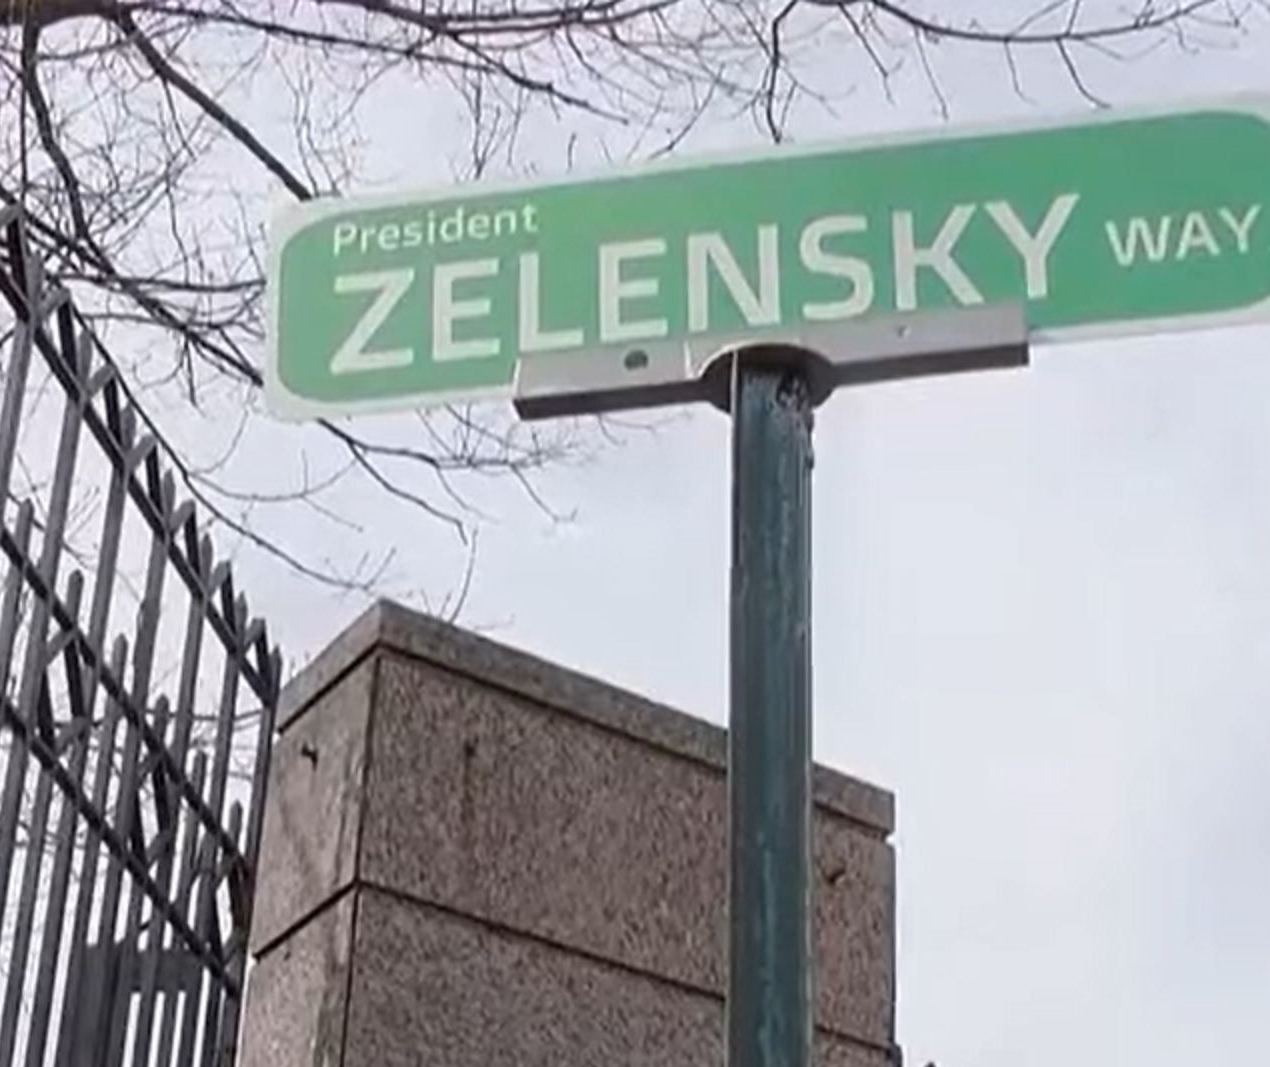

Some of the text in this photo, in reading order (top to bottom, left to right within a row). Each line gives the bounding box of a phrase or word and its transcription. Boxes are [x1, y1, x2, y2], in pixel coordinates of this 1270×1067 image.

[330, 192, 1261, 376] ZELENSKY WAY
[332, 202, 538, 258] President
